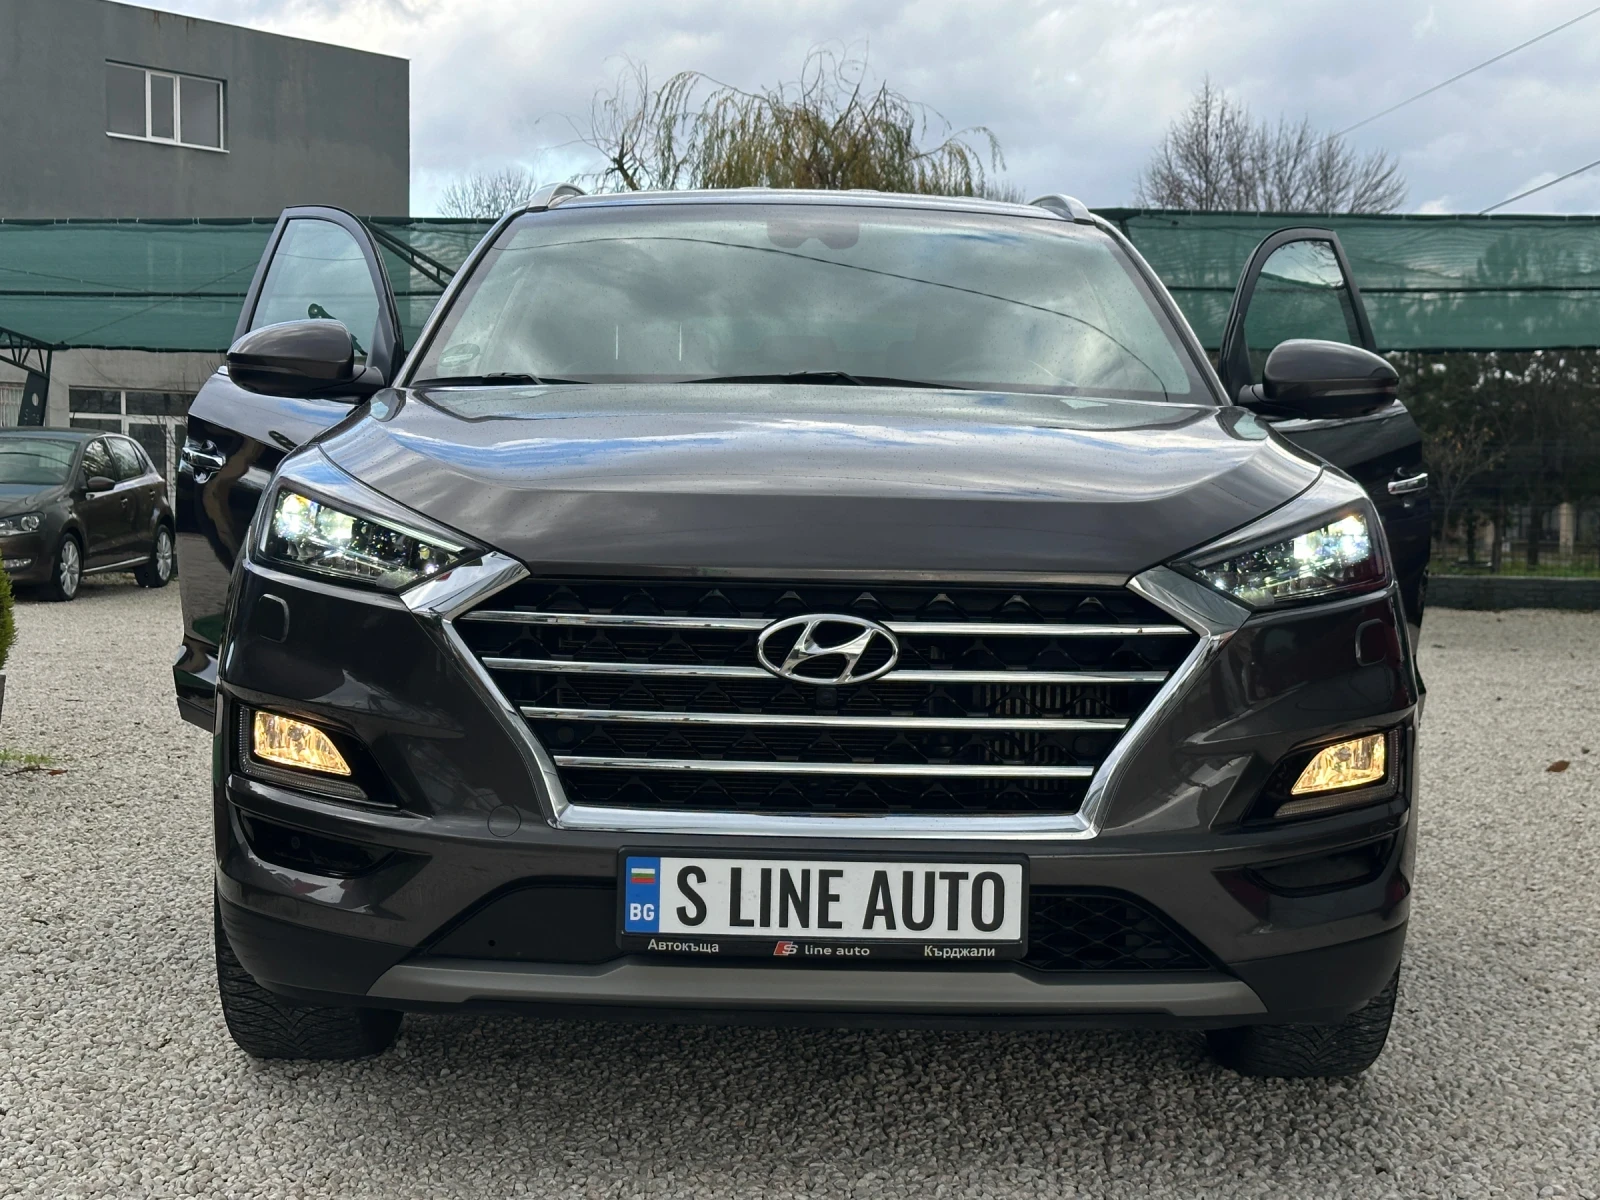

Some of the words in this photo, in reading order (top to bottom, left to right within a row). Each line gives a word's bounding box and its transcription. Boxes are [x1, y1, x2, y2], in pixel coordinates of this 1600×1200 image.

[676, 865, 707, 927] S
[729, 866, 844, 929] LINE
[862, 869, 1006, 932] AUTO
[629, 903, 655, 921] BG
[647, 938, 719, 953] Автокъща
[804, 944, 832, 955] line
[836, 946, 870, 956] auto
[923, 945, 996, 959] Кърджали
